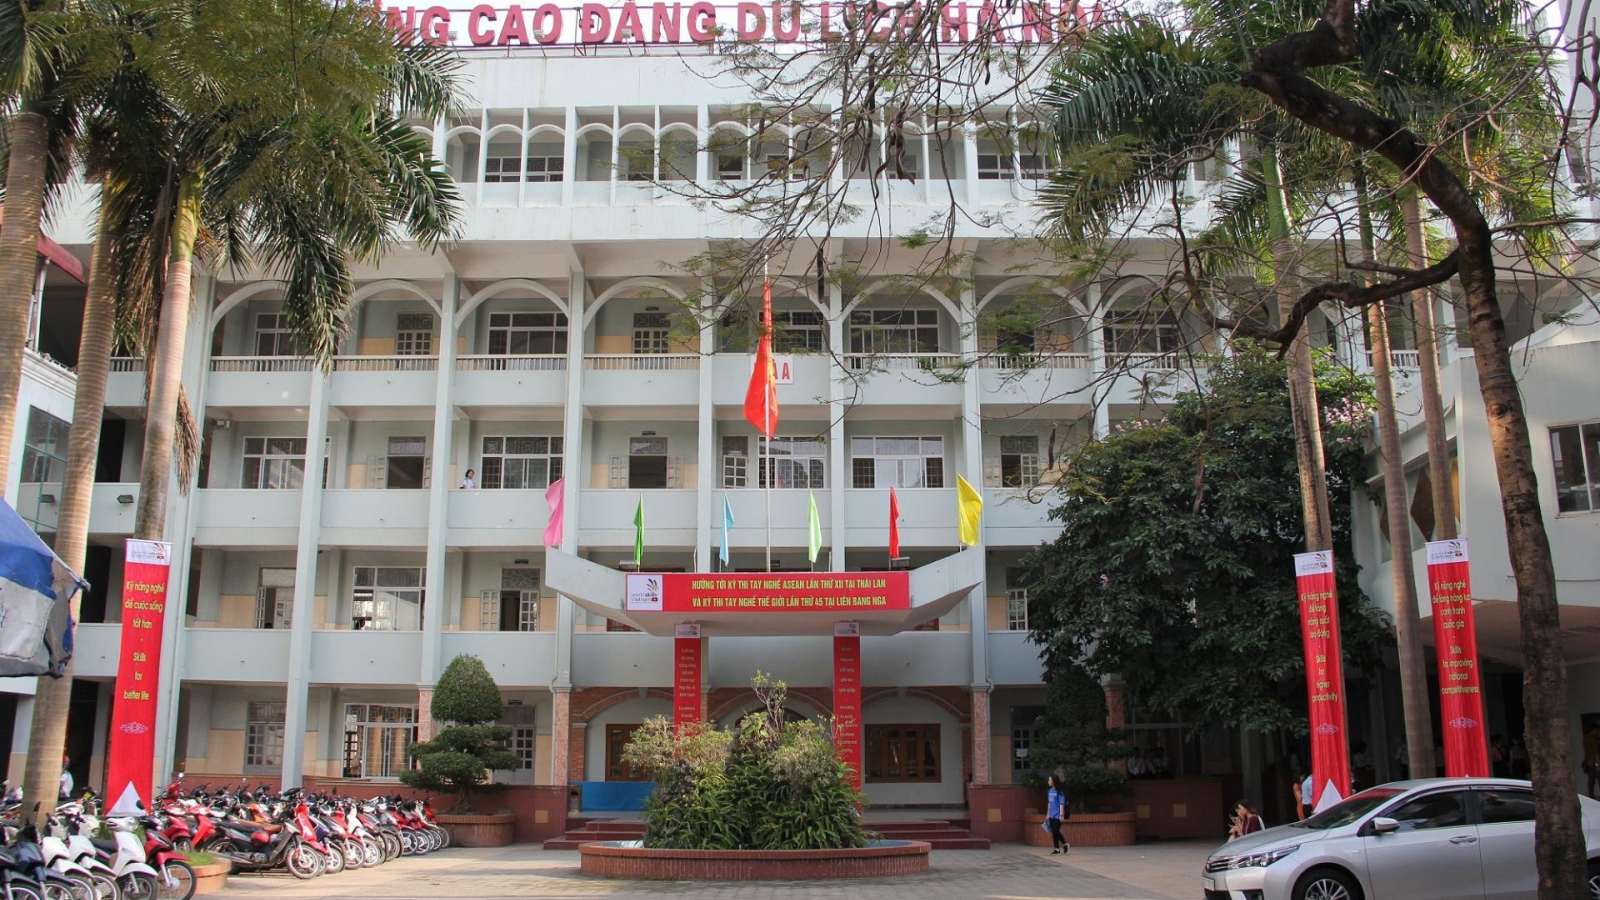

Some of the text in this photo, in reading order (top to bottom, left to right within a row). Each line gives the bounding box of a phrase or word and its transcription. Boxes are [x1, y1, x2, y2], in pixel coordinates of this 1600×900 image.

[468, 3, 563, 45] CAO
[737, 2, 802, 42] DU
[781, 362, 790, 380] A
[738, 580, 748, 590] THI
[749, 580, 762, 590] TAY
[783, 579, 804, 589] ASEAN
[834, 579, 844, 589] XII
[856, 577, 871, 589] THÁI
[872, 579, 886, 589] LAN
[713, 597, 724, 607] THI
[725, 597, 736, 607] TAY
[815, 597, 823, 606] 45
[853, 596, 871, 606] BANG
[872, 596, 887, 605] NGA
[133, 652, 147, 662] Skills
[135, 671, 143, 681] for
[124, 690, 149, 700] better life
